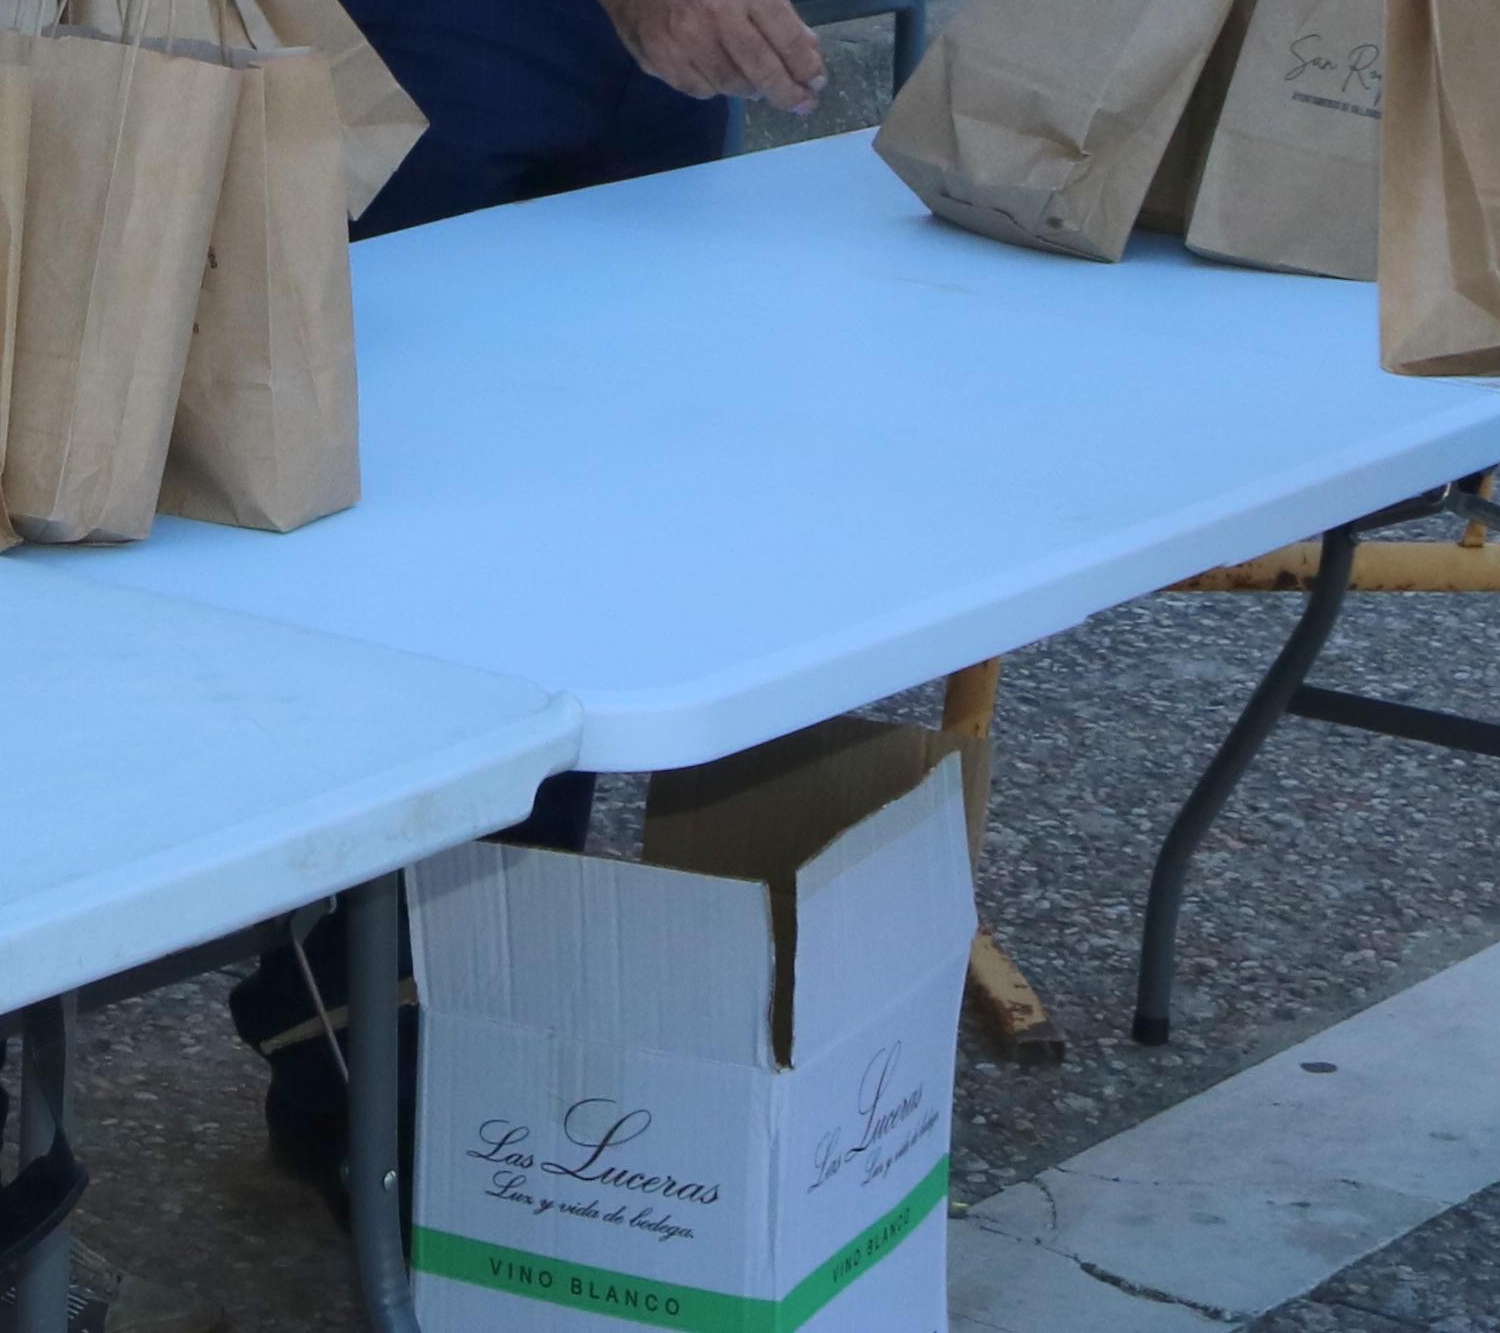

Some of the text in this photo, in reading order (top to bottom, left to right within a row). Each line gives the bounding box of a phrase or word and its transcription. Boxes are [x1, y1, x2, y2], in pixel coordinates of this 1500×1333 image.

[1285, 34, 1338, 81] San
[844, 1040, 923, 1164] Luceras
[466, 1098, 720, 1205] Las Luceras
[533, 1199, 554, 1215] y
[559, 1199, 600, 1220] vida
[602, 1206, 627, 1225] de
[832, 1207, 911, 1284] VINO BLANCO
[490, 1257, 680, 1316] VINO BLANCO
